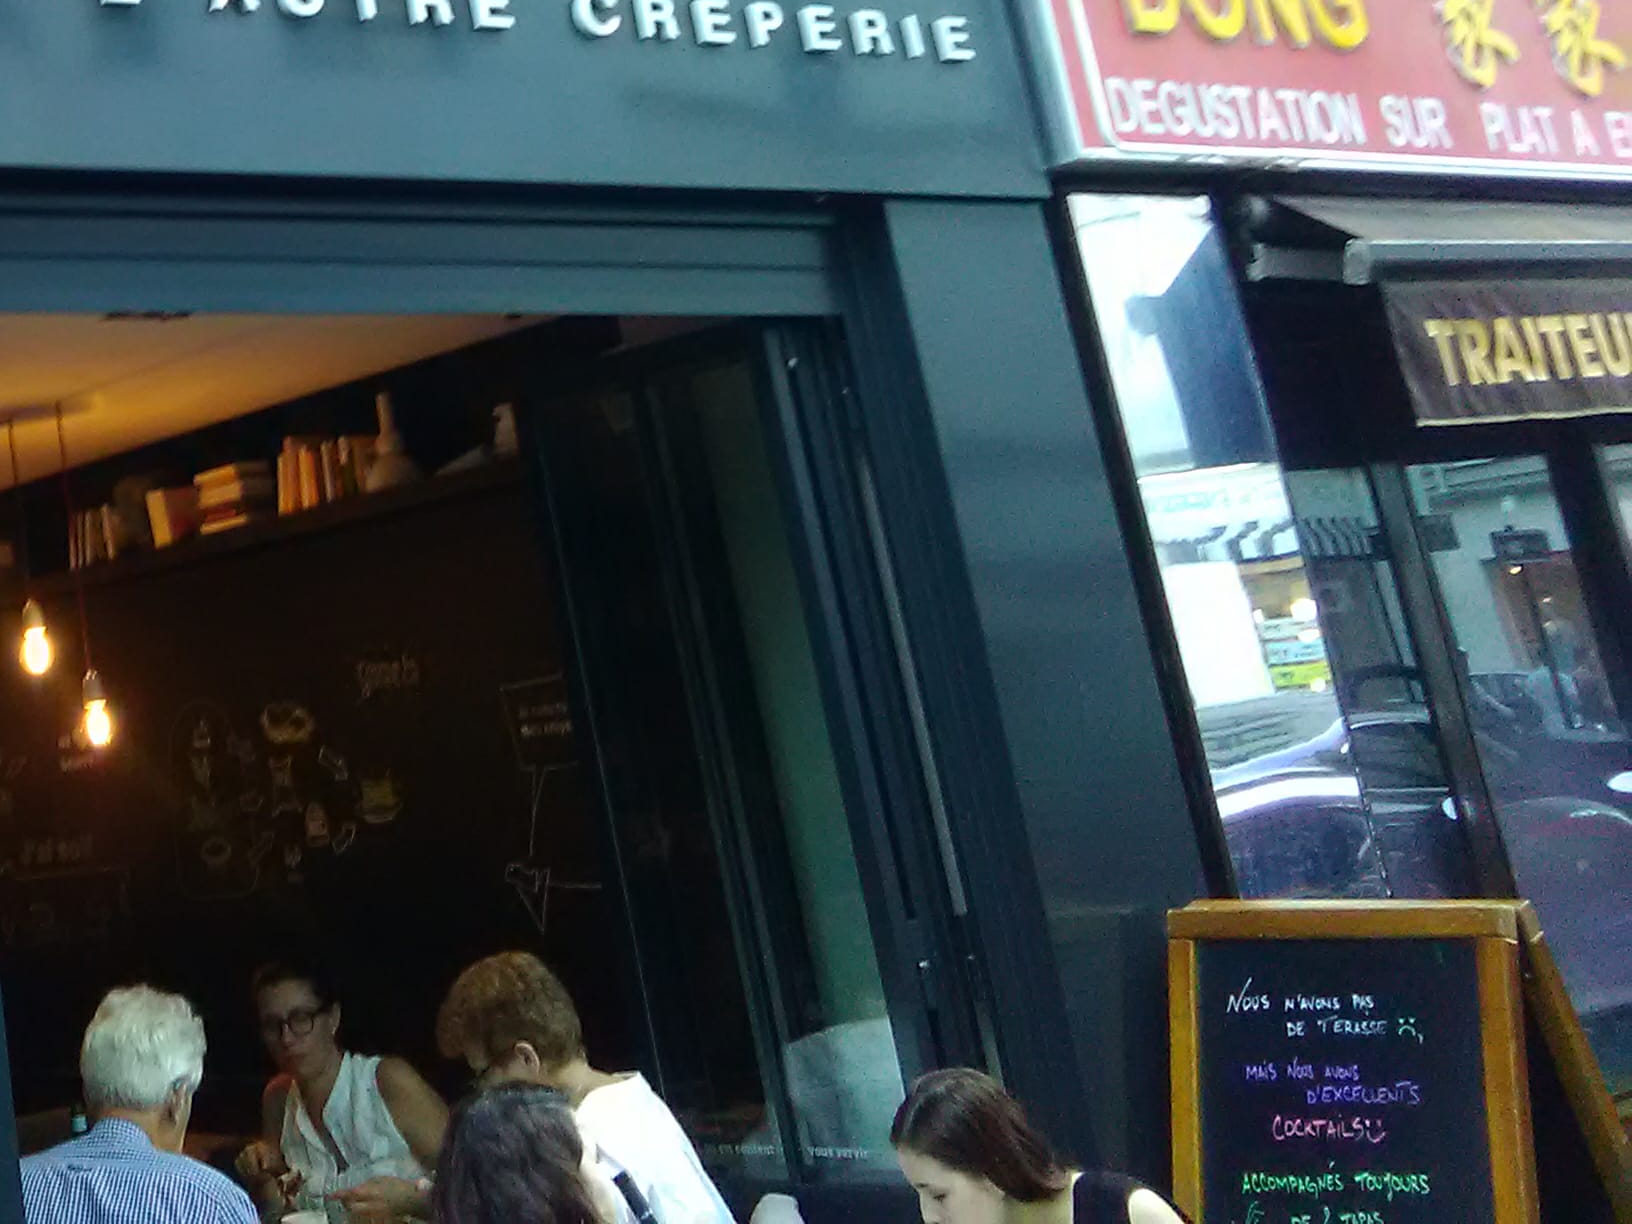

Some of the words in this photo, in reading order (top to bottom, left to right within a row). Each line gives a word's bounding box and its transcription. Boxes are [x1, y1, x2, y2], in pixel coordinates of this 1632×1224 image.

[1104, 77, 1367, 146] DEGUSTATION
[1379, 96, 1453, 150] SUR
[1479, 101, 1559, 155] PLAT
[1570, 108, 1601, 157] A
[1423, 312, 1632, 387] TRAITEU
[1352, 992, 1376, 1012] PAS
[1286, 1021, 1305, 1038] DE
